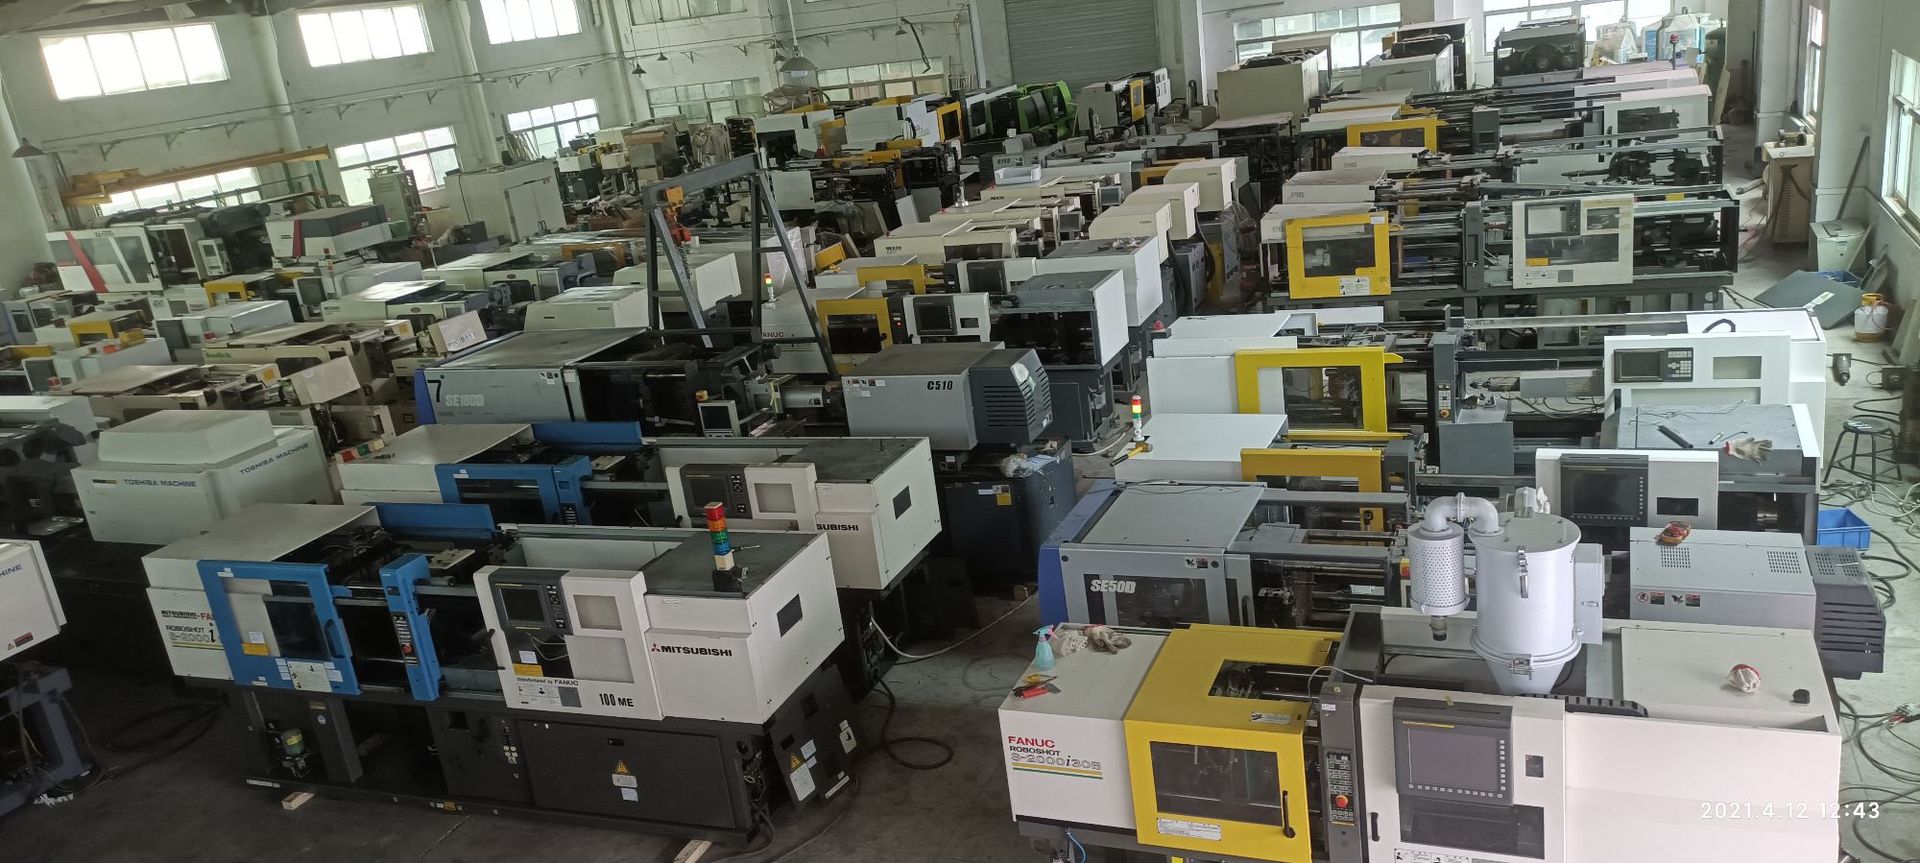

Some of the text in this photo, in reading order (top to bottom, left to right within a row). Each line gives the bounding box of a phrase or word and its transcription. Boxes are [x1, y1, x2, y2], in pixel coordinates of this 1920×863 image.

[427, 379, 442, 403] 7
[927, 380, 953, 391] C510
[239, 442, 309, 475] TOSHIBA MACHINE
[123, 478, 198, 488] TOSHIBA MACHINE
[1090, 579, 1136, 594] SE50D
[166, 624, 205, 633] ROBOSHOT
[660, 645, 733, 657] MITSUBISHI
[554, 679, 579, 687] FANUC
[599, 693, 634, 707] 100 ME
[1008, 735, 1056, 749] FANUC
[1009, 745, 1061, 757] ROBOSHOT
[1011, 753, 1102, 771] S-2000i30B
